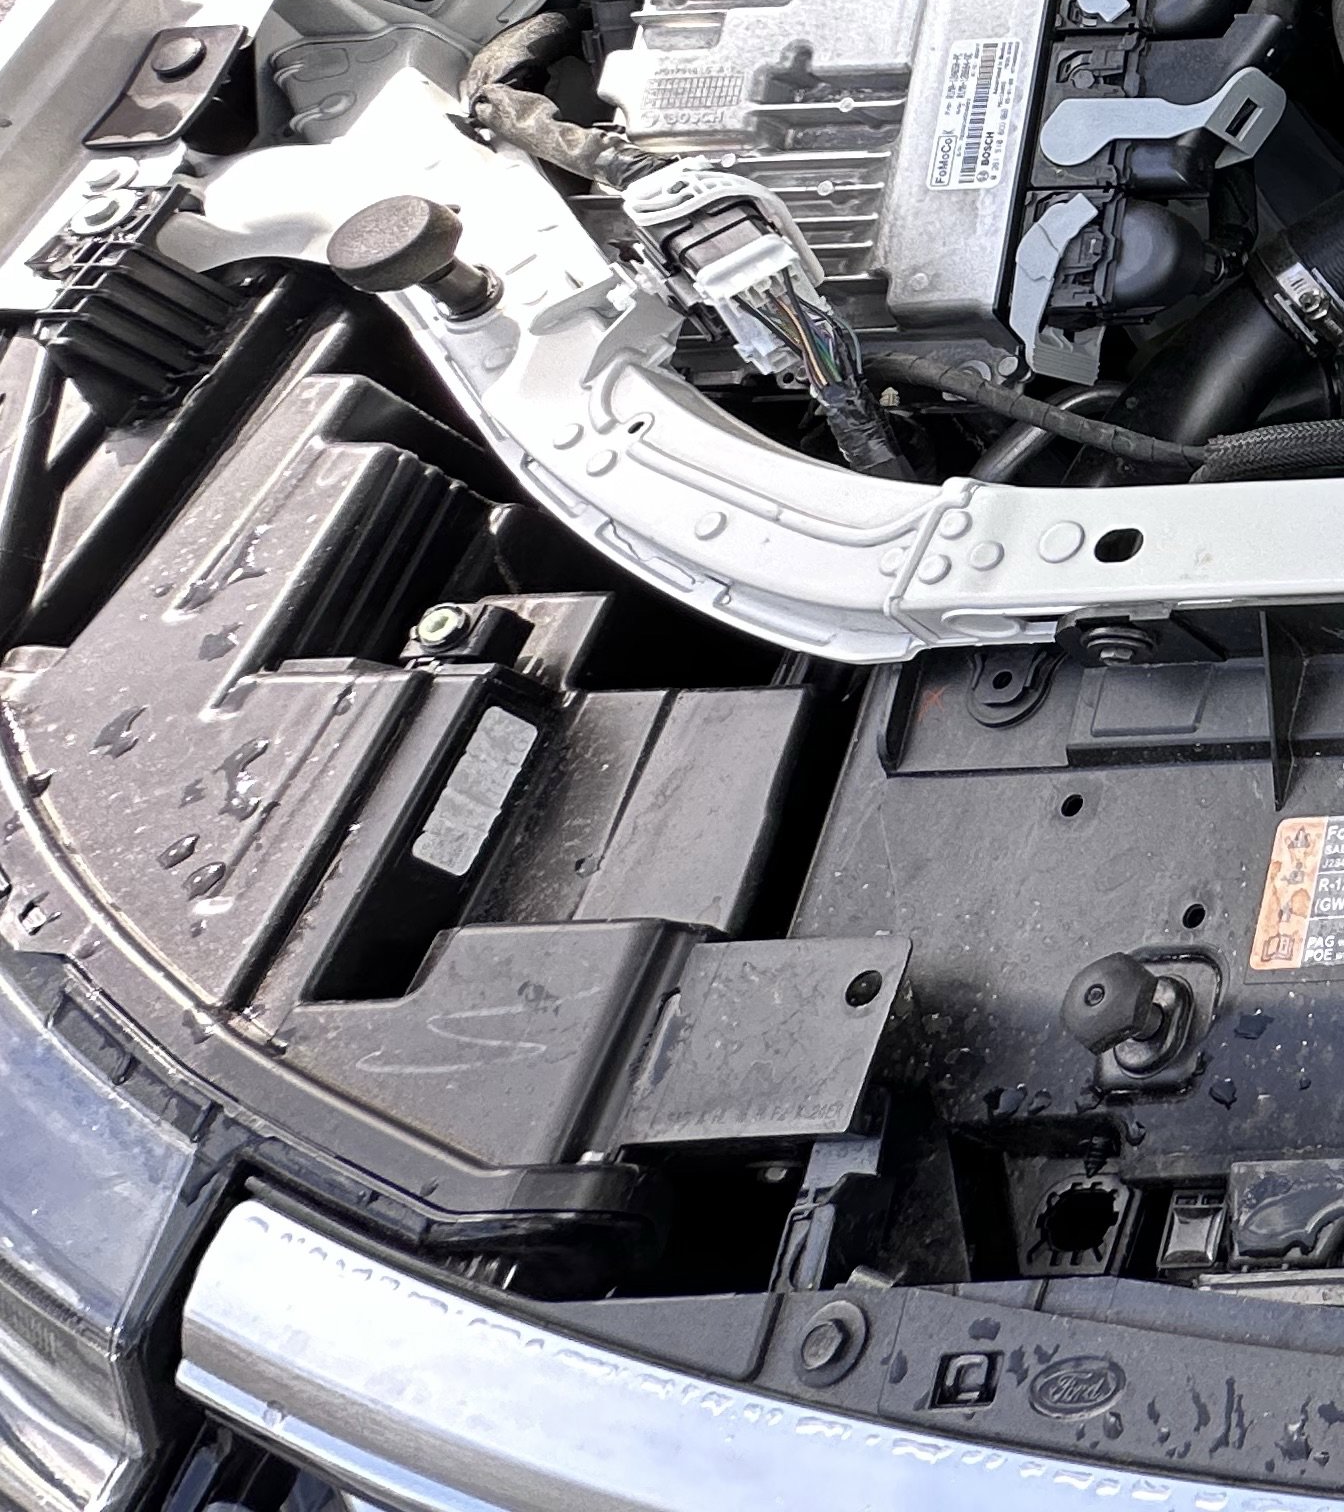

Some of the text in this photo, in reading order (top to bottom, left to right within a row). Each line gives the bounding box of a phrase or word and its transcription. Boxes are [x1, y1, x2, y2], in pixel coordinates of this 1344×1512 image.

[934, 137, 953, 184] FoMoCo
[980, 131, 994, 167] BOSCH
[1303, 948, 1334, 962] POE
[1306, 935, 1335, 949] PAG
[1048, 1371, 1106, 1404] Ford
